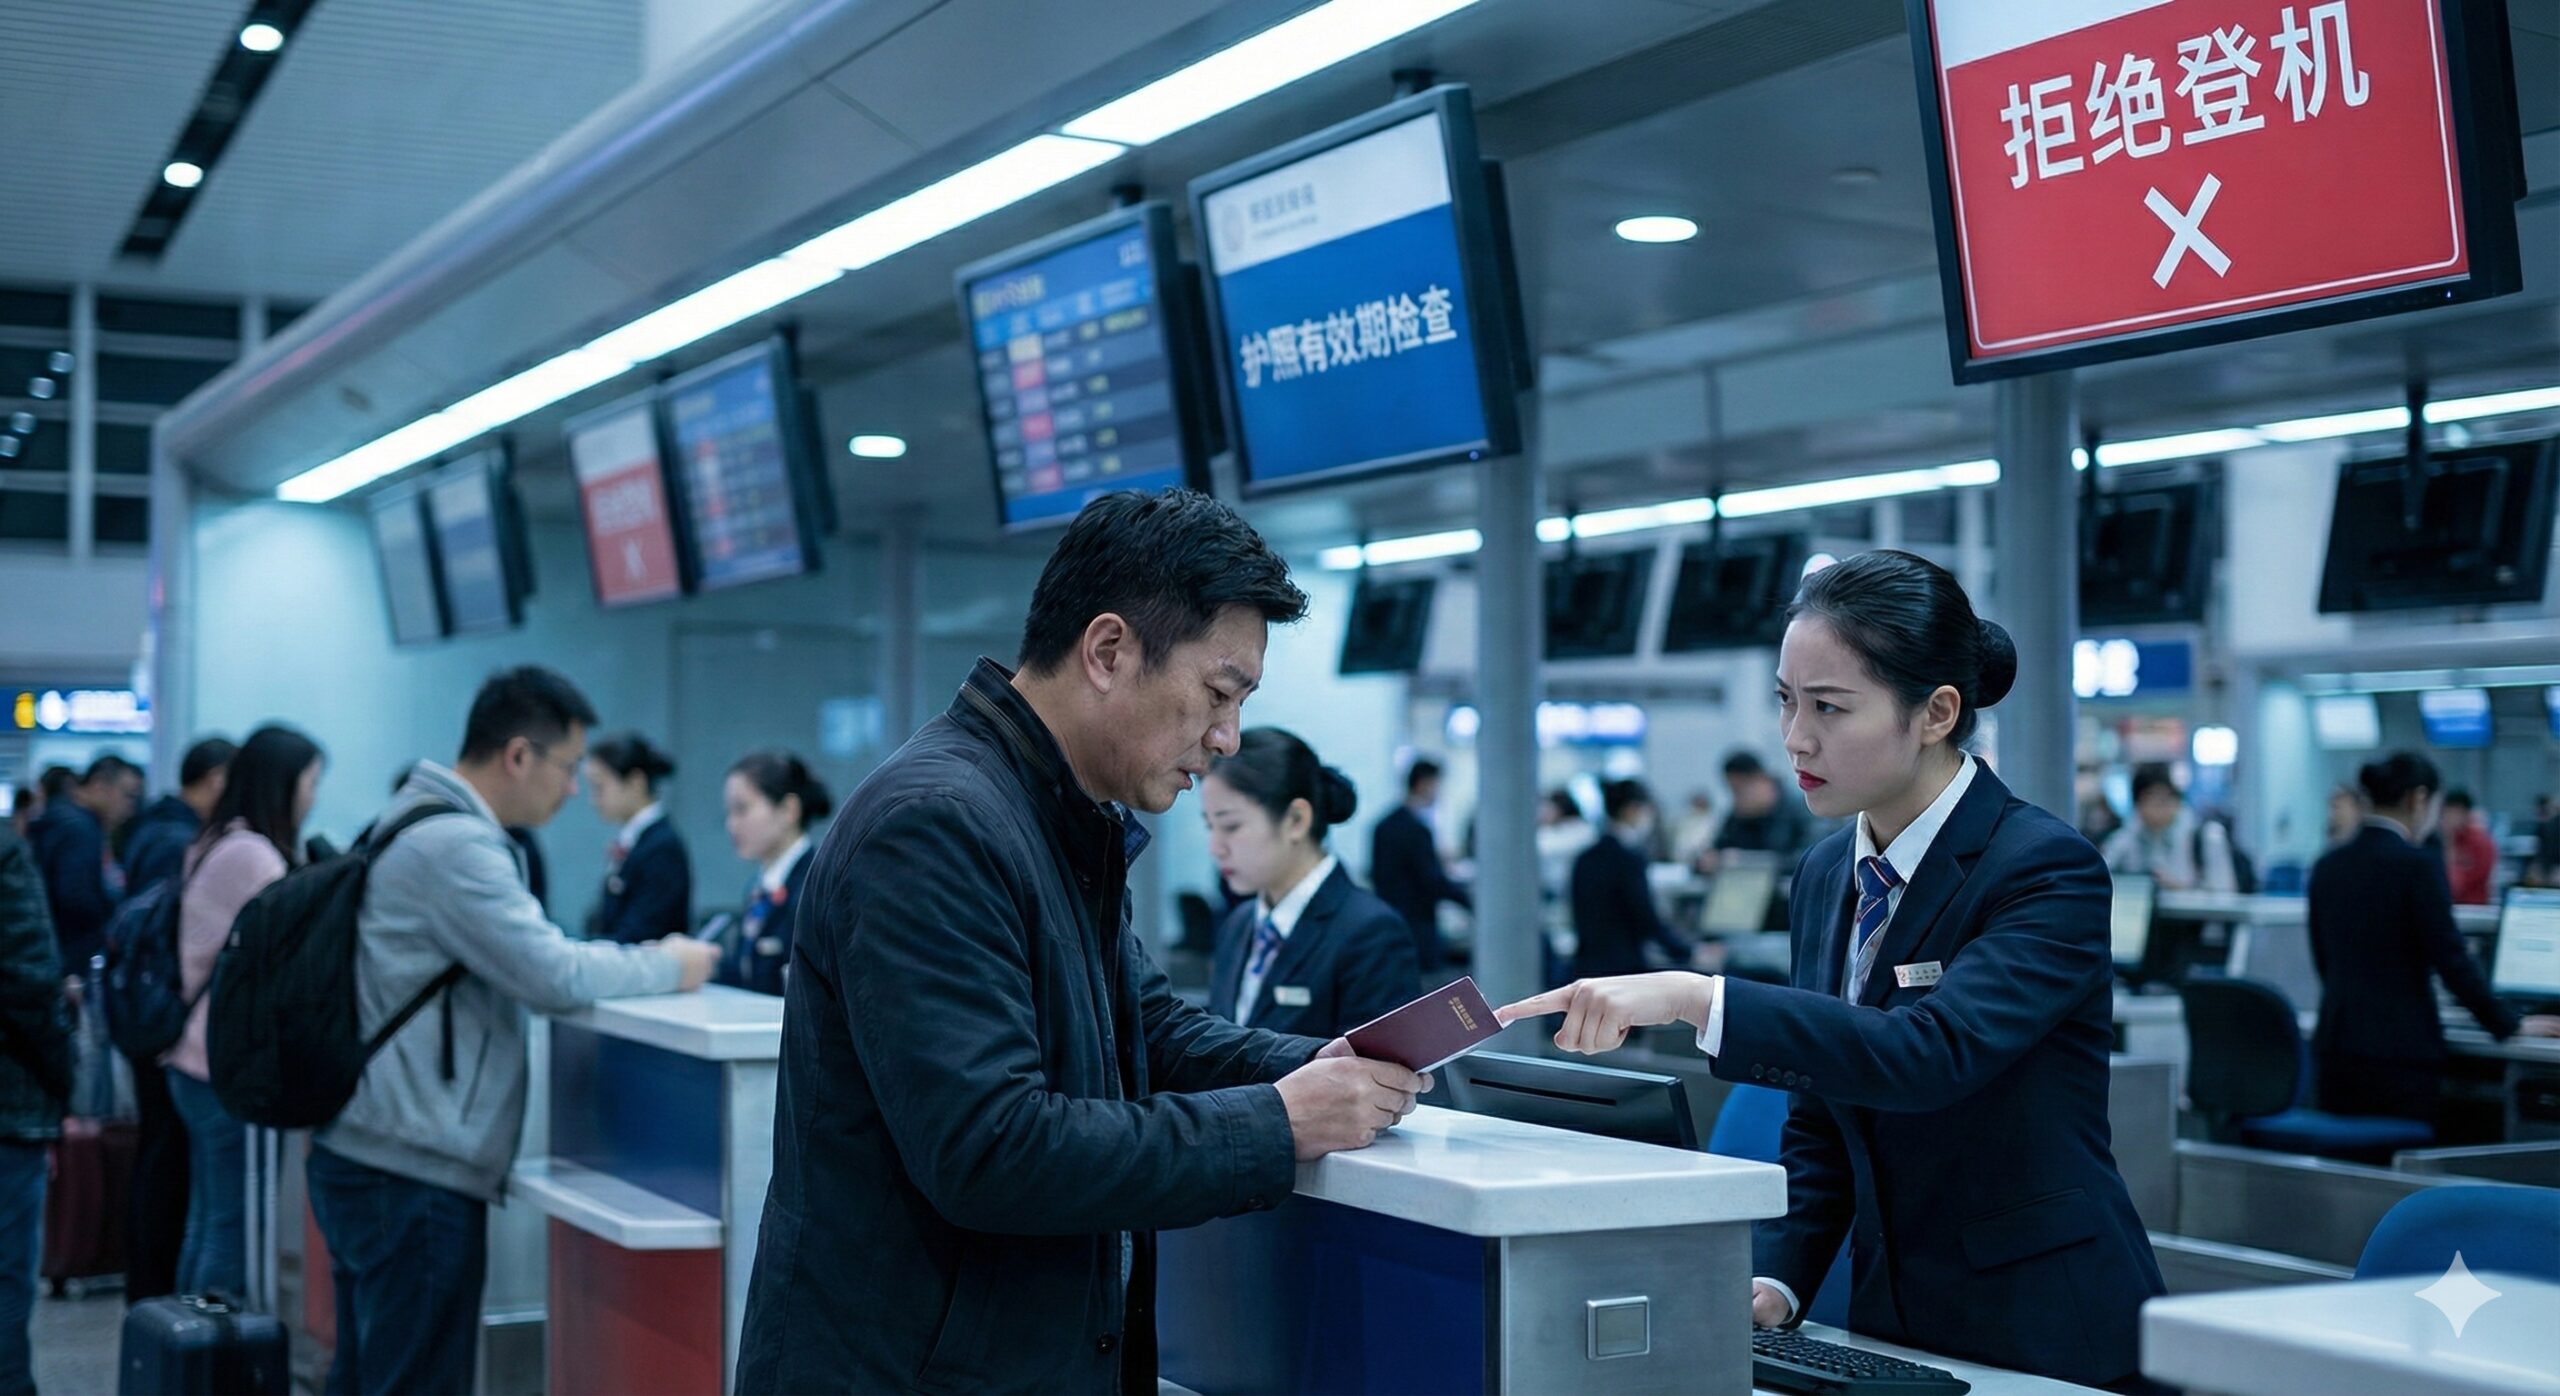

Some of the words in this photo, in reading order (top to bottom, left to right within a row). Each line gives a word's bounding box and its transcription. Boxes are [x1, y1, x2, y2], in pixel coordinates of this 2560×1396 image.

[2000, 0, 2370, 190] 拒绝登机
[1240, 283, 1458, 389] 护照有效期检查
